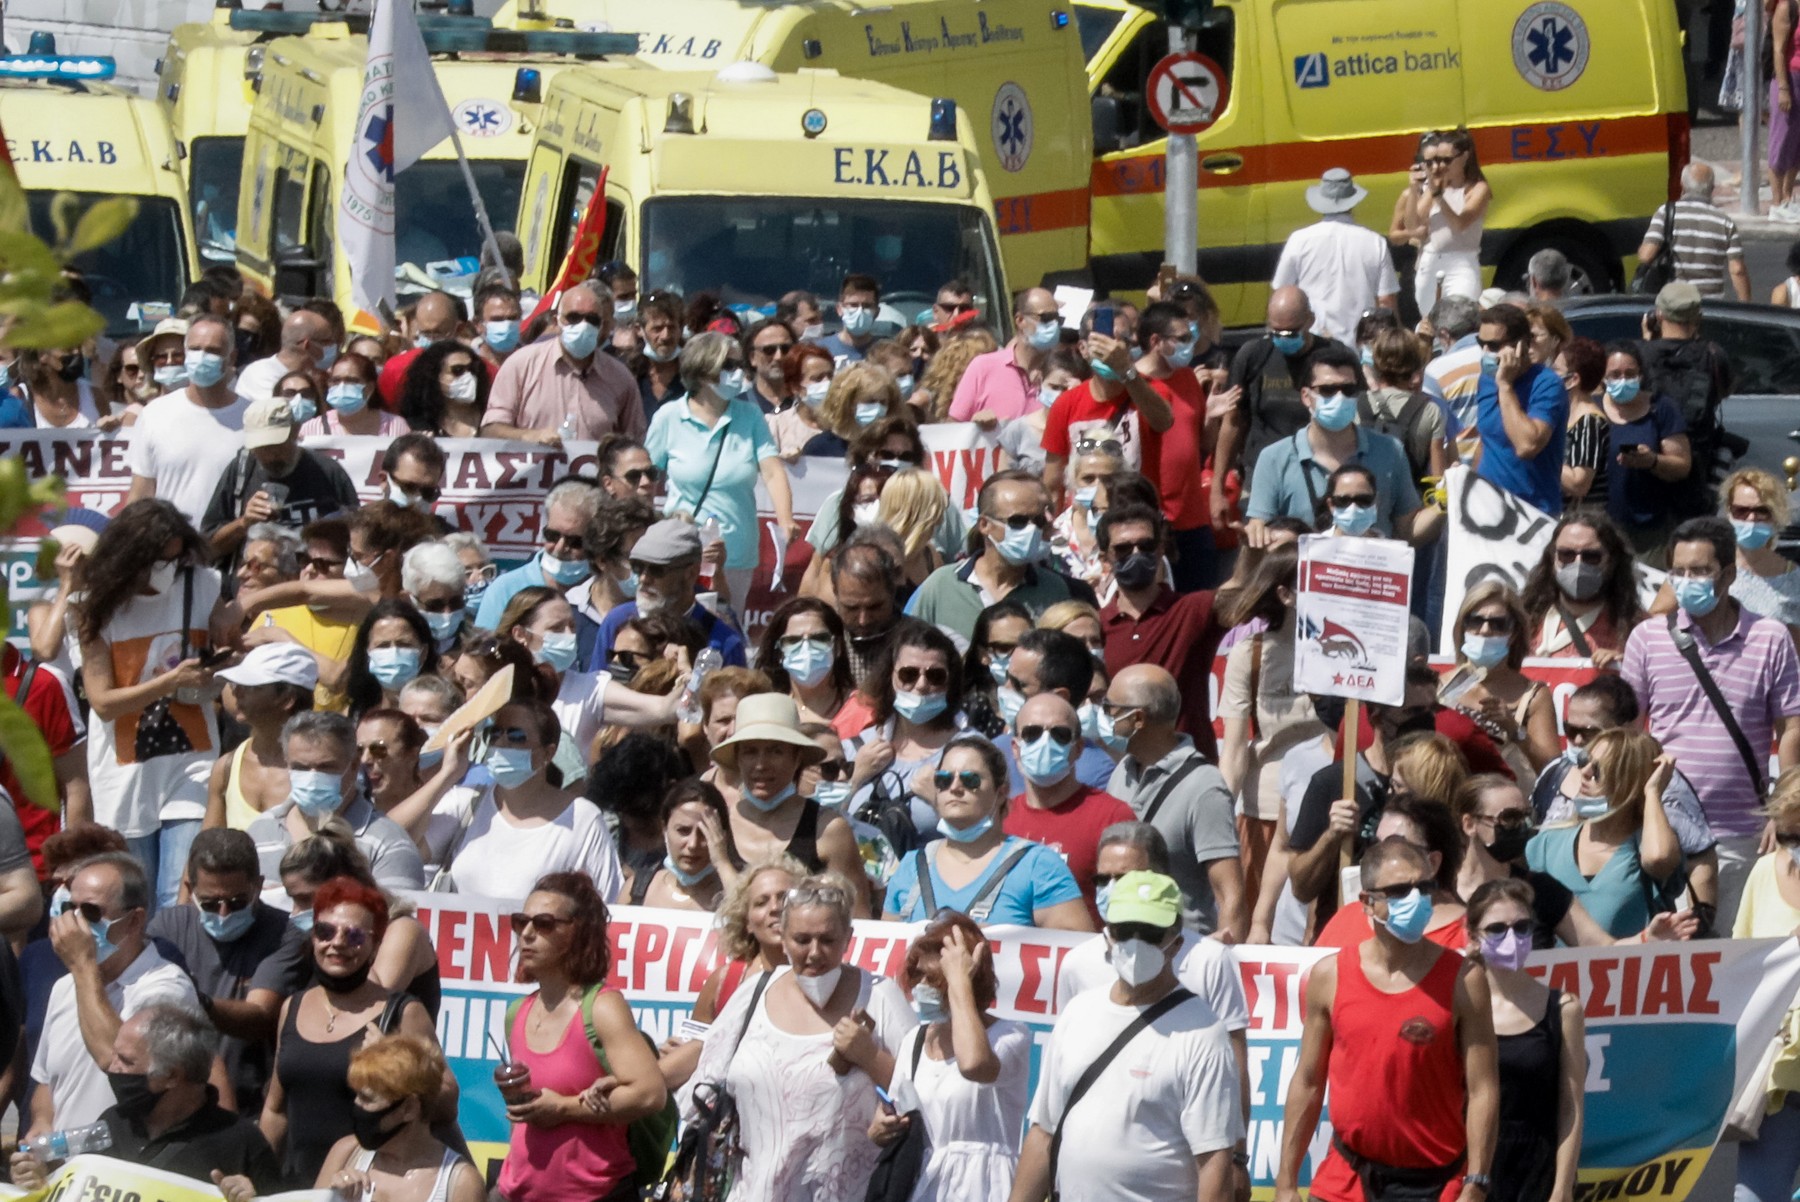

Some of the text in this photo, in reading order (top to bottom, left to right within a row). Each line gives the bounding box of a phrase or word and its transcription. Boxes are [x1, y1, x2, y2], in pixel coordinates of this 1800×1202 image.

[1334, 48, 1460, 77] attica bank
[834, 148, 960, 189] Ε.Κ.Α.Β
[0, 440, 132, 479] ΑΝΕ
[1346, 674, 1376, 688] ΔΕΑ
[1525, 952, 1721, 1019] ΑΣΙΑΣ
